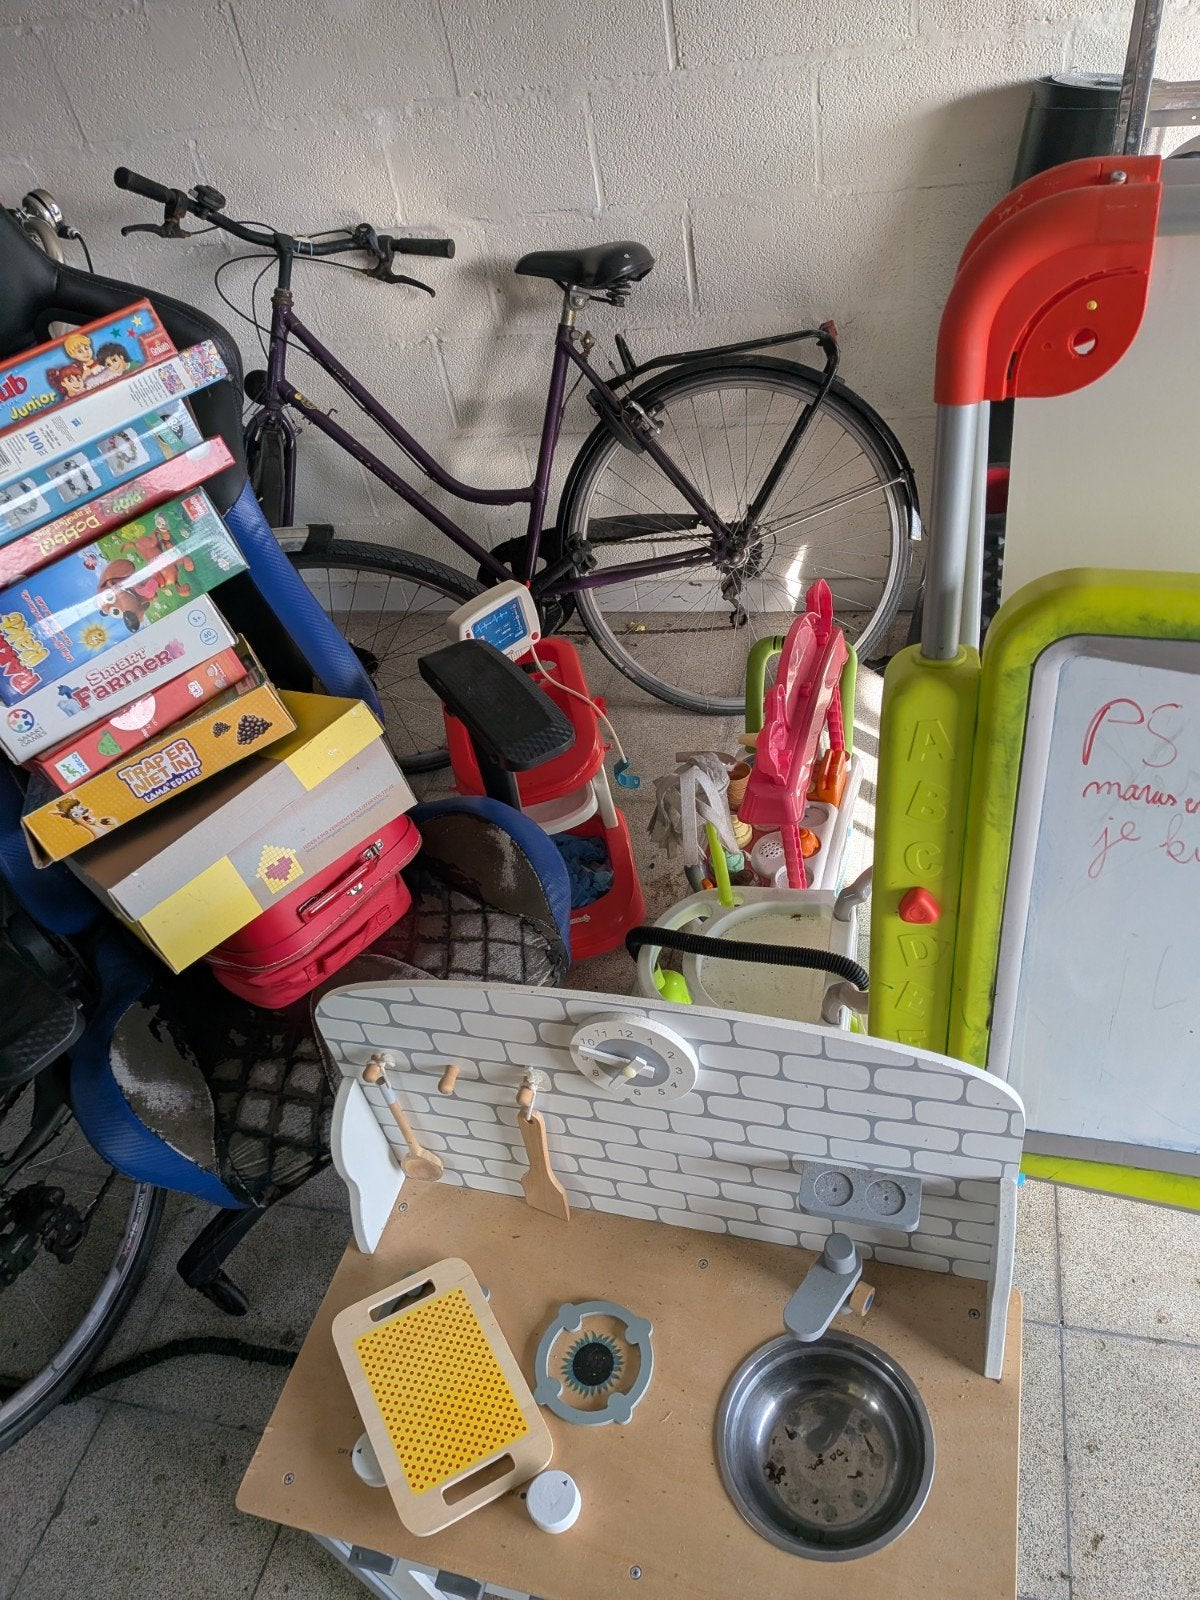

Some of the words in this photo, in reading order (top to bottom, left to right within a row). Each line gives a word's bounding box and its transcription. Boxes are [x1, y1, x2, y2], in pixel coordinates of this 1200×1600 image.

[11, 391, 56, 420] Junior
[25, 430, 45, 451] 100
[1082, 698, 1183, 768] PS
[121, 754, 164, 783] TRAP
[164, 741, 191, 762] ER
[133, 765, 172, 796] NIET
[170, 767, 202, 789] EDITIE
[905, 780, 951, 821] B
[1088, 816, 1142, 879] je
[897, 933, 940, 967] D
[595, 1029, 608, 1038] 11
[618, 1029, 635, 1039] 12
[580, 1038, 595, 1047] 10
[647, 1037, 654, 1046] 1
[667, 1051, 676, 1060] 2
[592, 1069, 600, 1077] 8
[675, 1066, 684, 1075] 3
[633, 1088, 642, 1096] 6
[657, 1088, 666, 1096] 5
